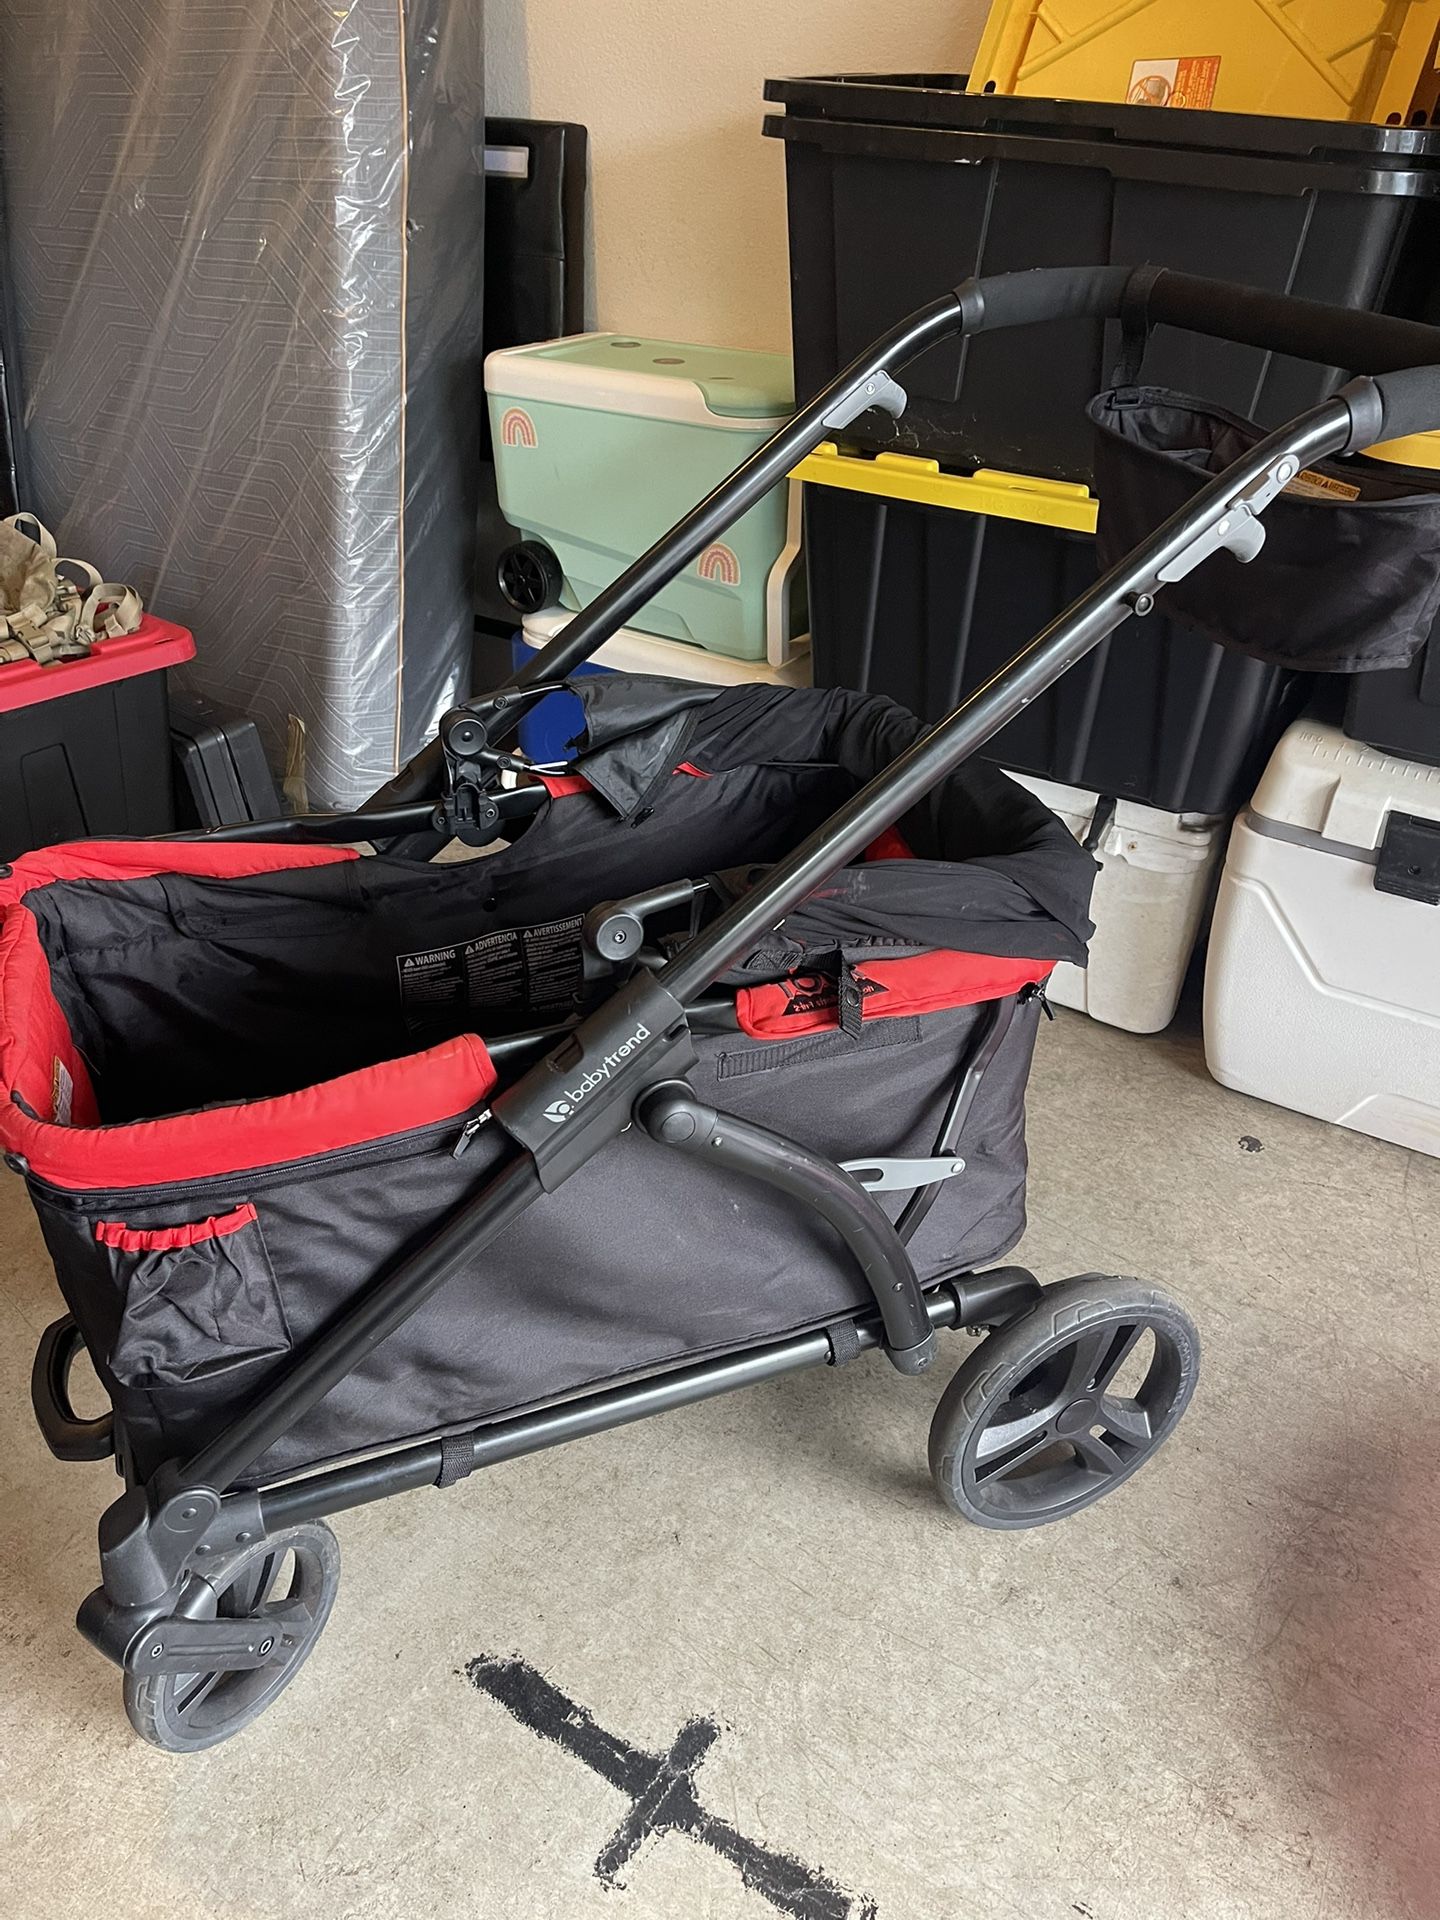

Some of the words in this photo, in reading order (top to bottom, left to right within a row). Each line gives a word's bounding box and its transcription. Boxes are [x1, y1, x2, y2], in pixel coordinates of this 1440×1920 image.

[533, 917, 583, 937] AVERTISSEMENT
[474, 931, 518, 952] ADVERTENCIA
[415, 949, 456, 965] WARNING
[564, 1022, 651, 1103] babytrend
